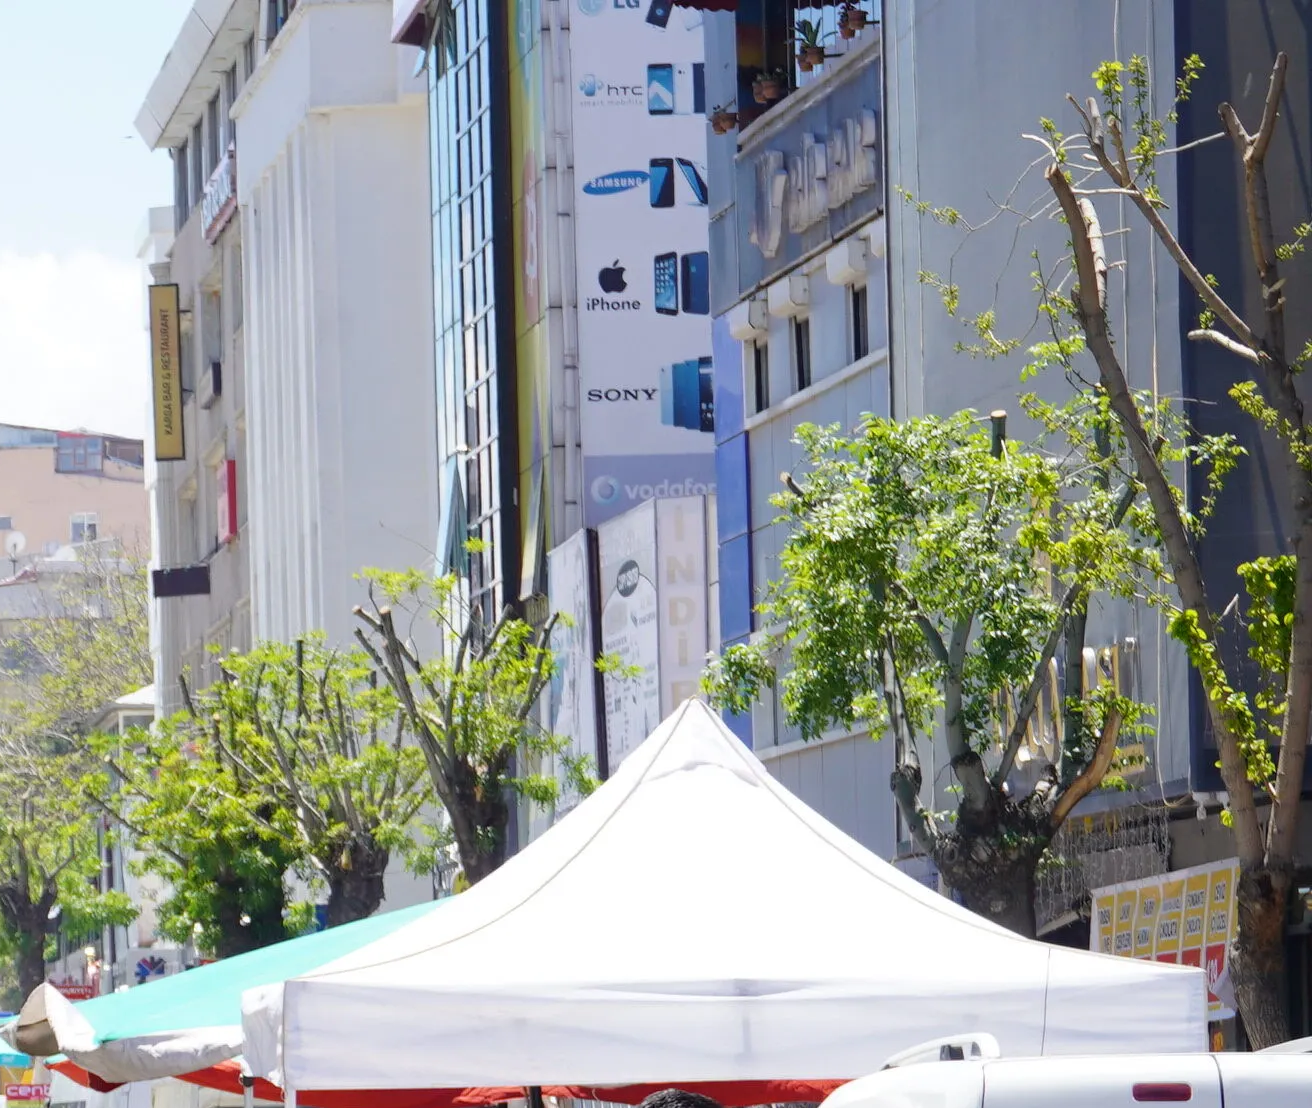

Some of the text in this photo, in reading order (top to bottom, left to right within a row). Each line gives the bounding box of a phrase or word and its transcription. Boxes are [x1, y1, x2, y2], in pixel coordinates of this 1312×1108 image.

[589, 177, 643, 188] SAMSUNG
[586, 297, 641, 311] iPhone
[587, 388, 658, 402] SONY
